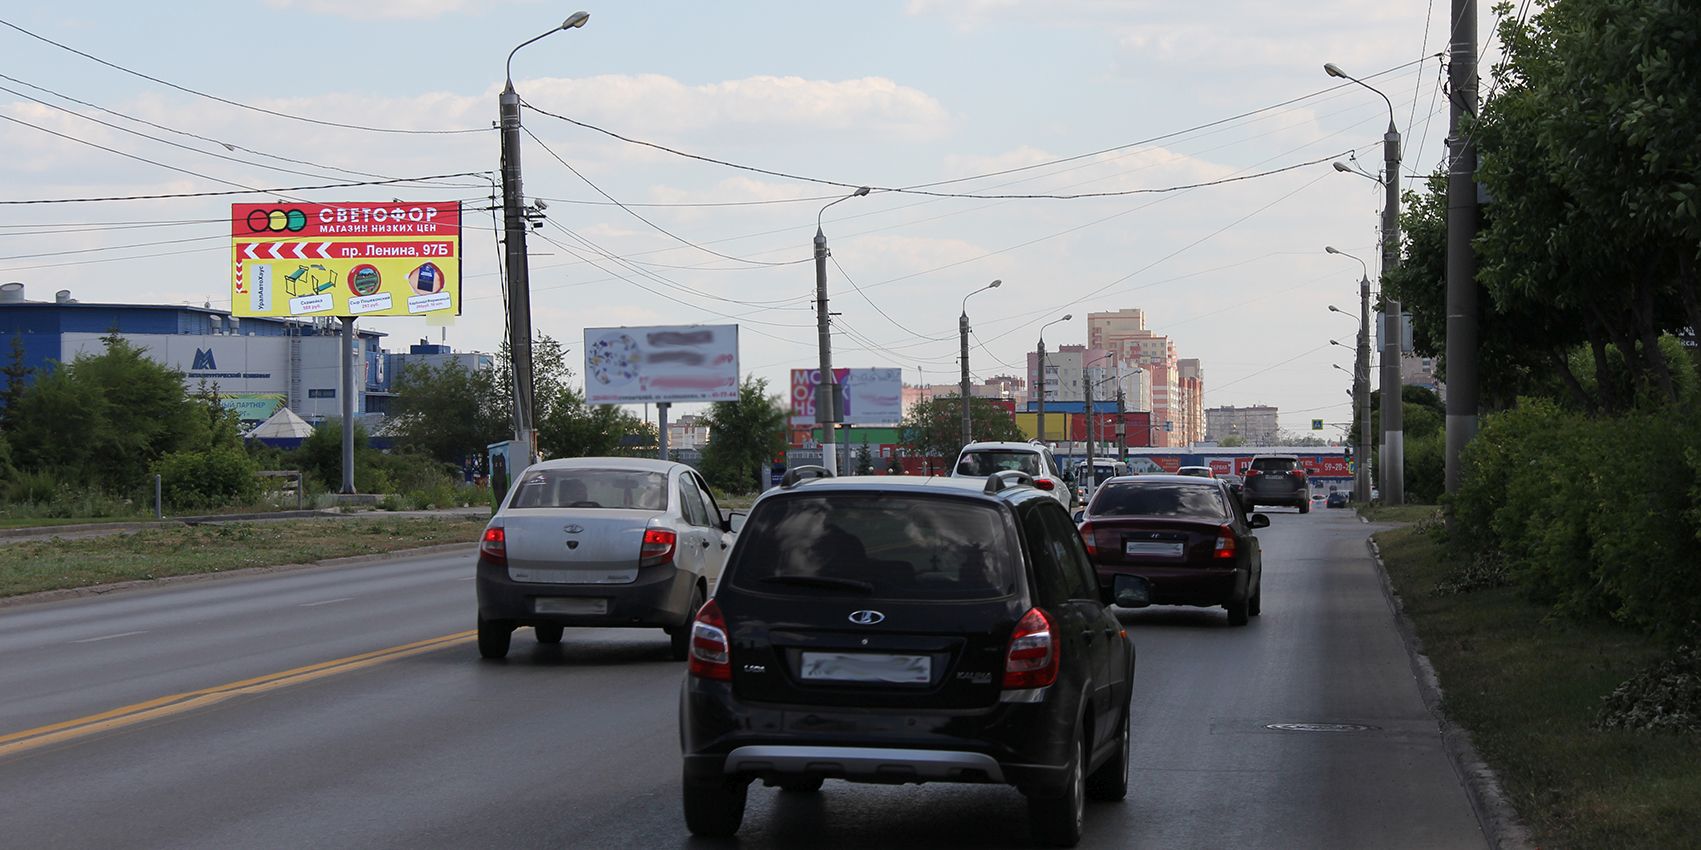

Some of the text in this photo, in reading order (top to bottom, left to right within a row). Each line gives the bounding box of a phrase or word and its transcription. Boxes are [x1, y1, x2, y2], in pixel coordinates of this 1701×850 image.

[319, 207, 438, 223] СВЕТОФОР
[319, 224, 437, 233] МАГАЗИН НИЗКИХ ЦЕН
[341, 243, 449, 258] пр. Ленина, 97Б
